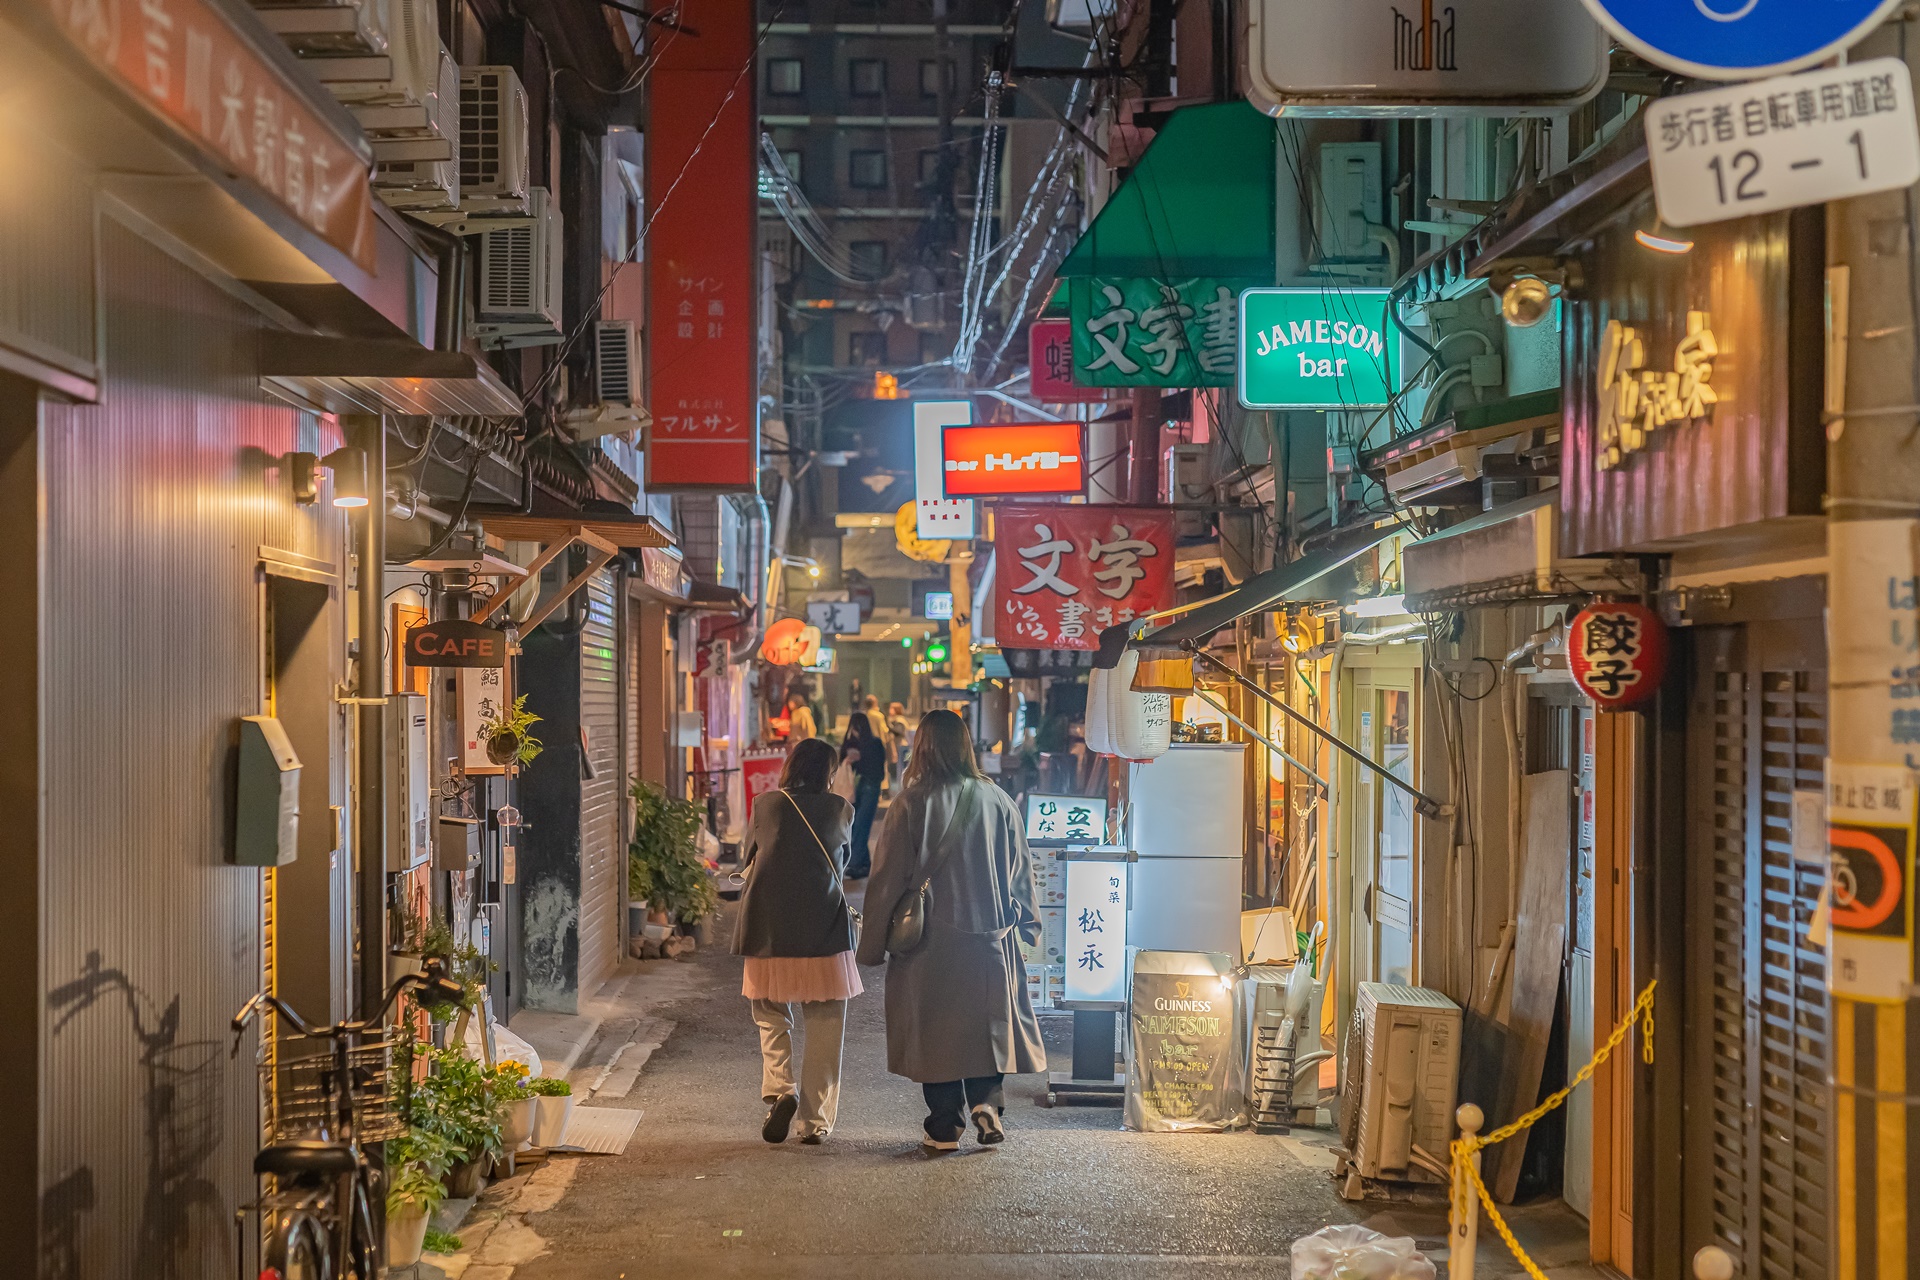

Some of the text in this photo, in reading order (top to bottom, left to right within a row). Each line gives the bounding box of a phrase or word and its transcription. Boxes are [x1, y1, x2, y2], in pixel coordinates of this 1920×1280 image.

[678, 277, 724, 293] サイン
[1256, 319, 1384, 358] JAMESON
[1297, 351, 1348, 378] bar
[660, 413, 740, 433] マルサン
[985, 451, 1078, 471] トレイー
[1011, 523, 1158, 600] 文字
[414, 632, 494, 657] CAFE
[1585, 613, 1641, 698] 餃子
[1078, 907, 1105, 972] 松永
[1154, 997, 1212, 1012] GUINNESS
[1139, 1015, 1220, 1037] JAMESON
[1161, 1039, 1199, 1057] bar
